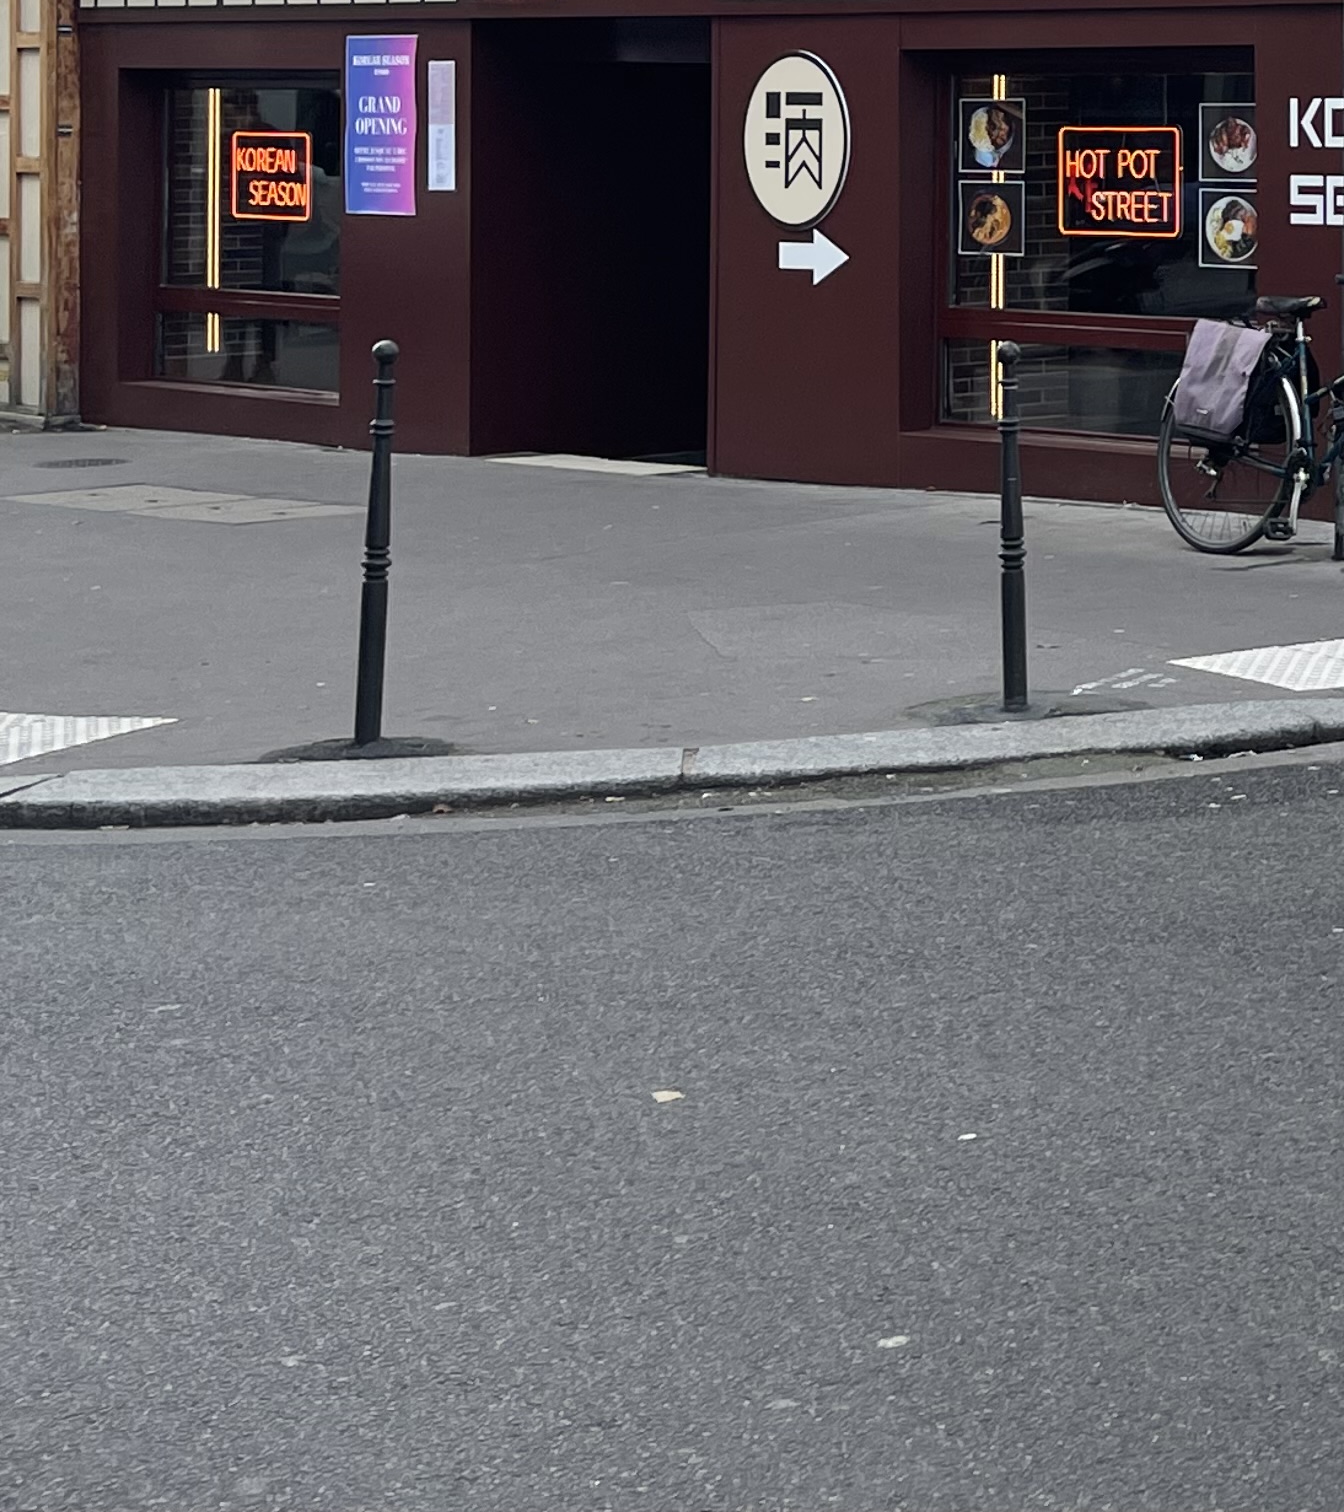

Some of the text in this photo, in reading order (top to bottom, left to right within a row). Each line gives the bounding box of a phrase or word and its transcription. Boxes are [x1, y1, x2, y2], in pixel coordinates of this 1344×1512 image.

[358, 95, 402, 114] GRAND
[355, 117, 408, 135] OPENING
[236, 146, 296, 174] KOREAN
[1065, 149, 1161, 179] HOT POT
[248, 179, 307, 206] SEASON
[1091, 191, 1173, 223] STREET
